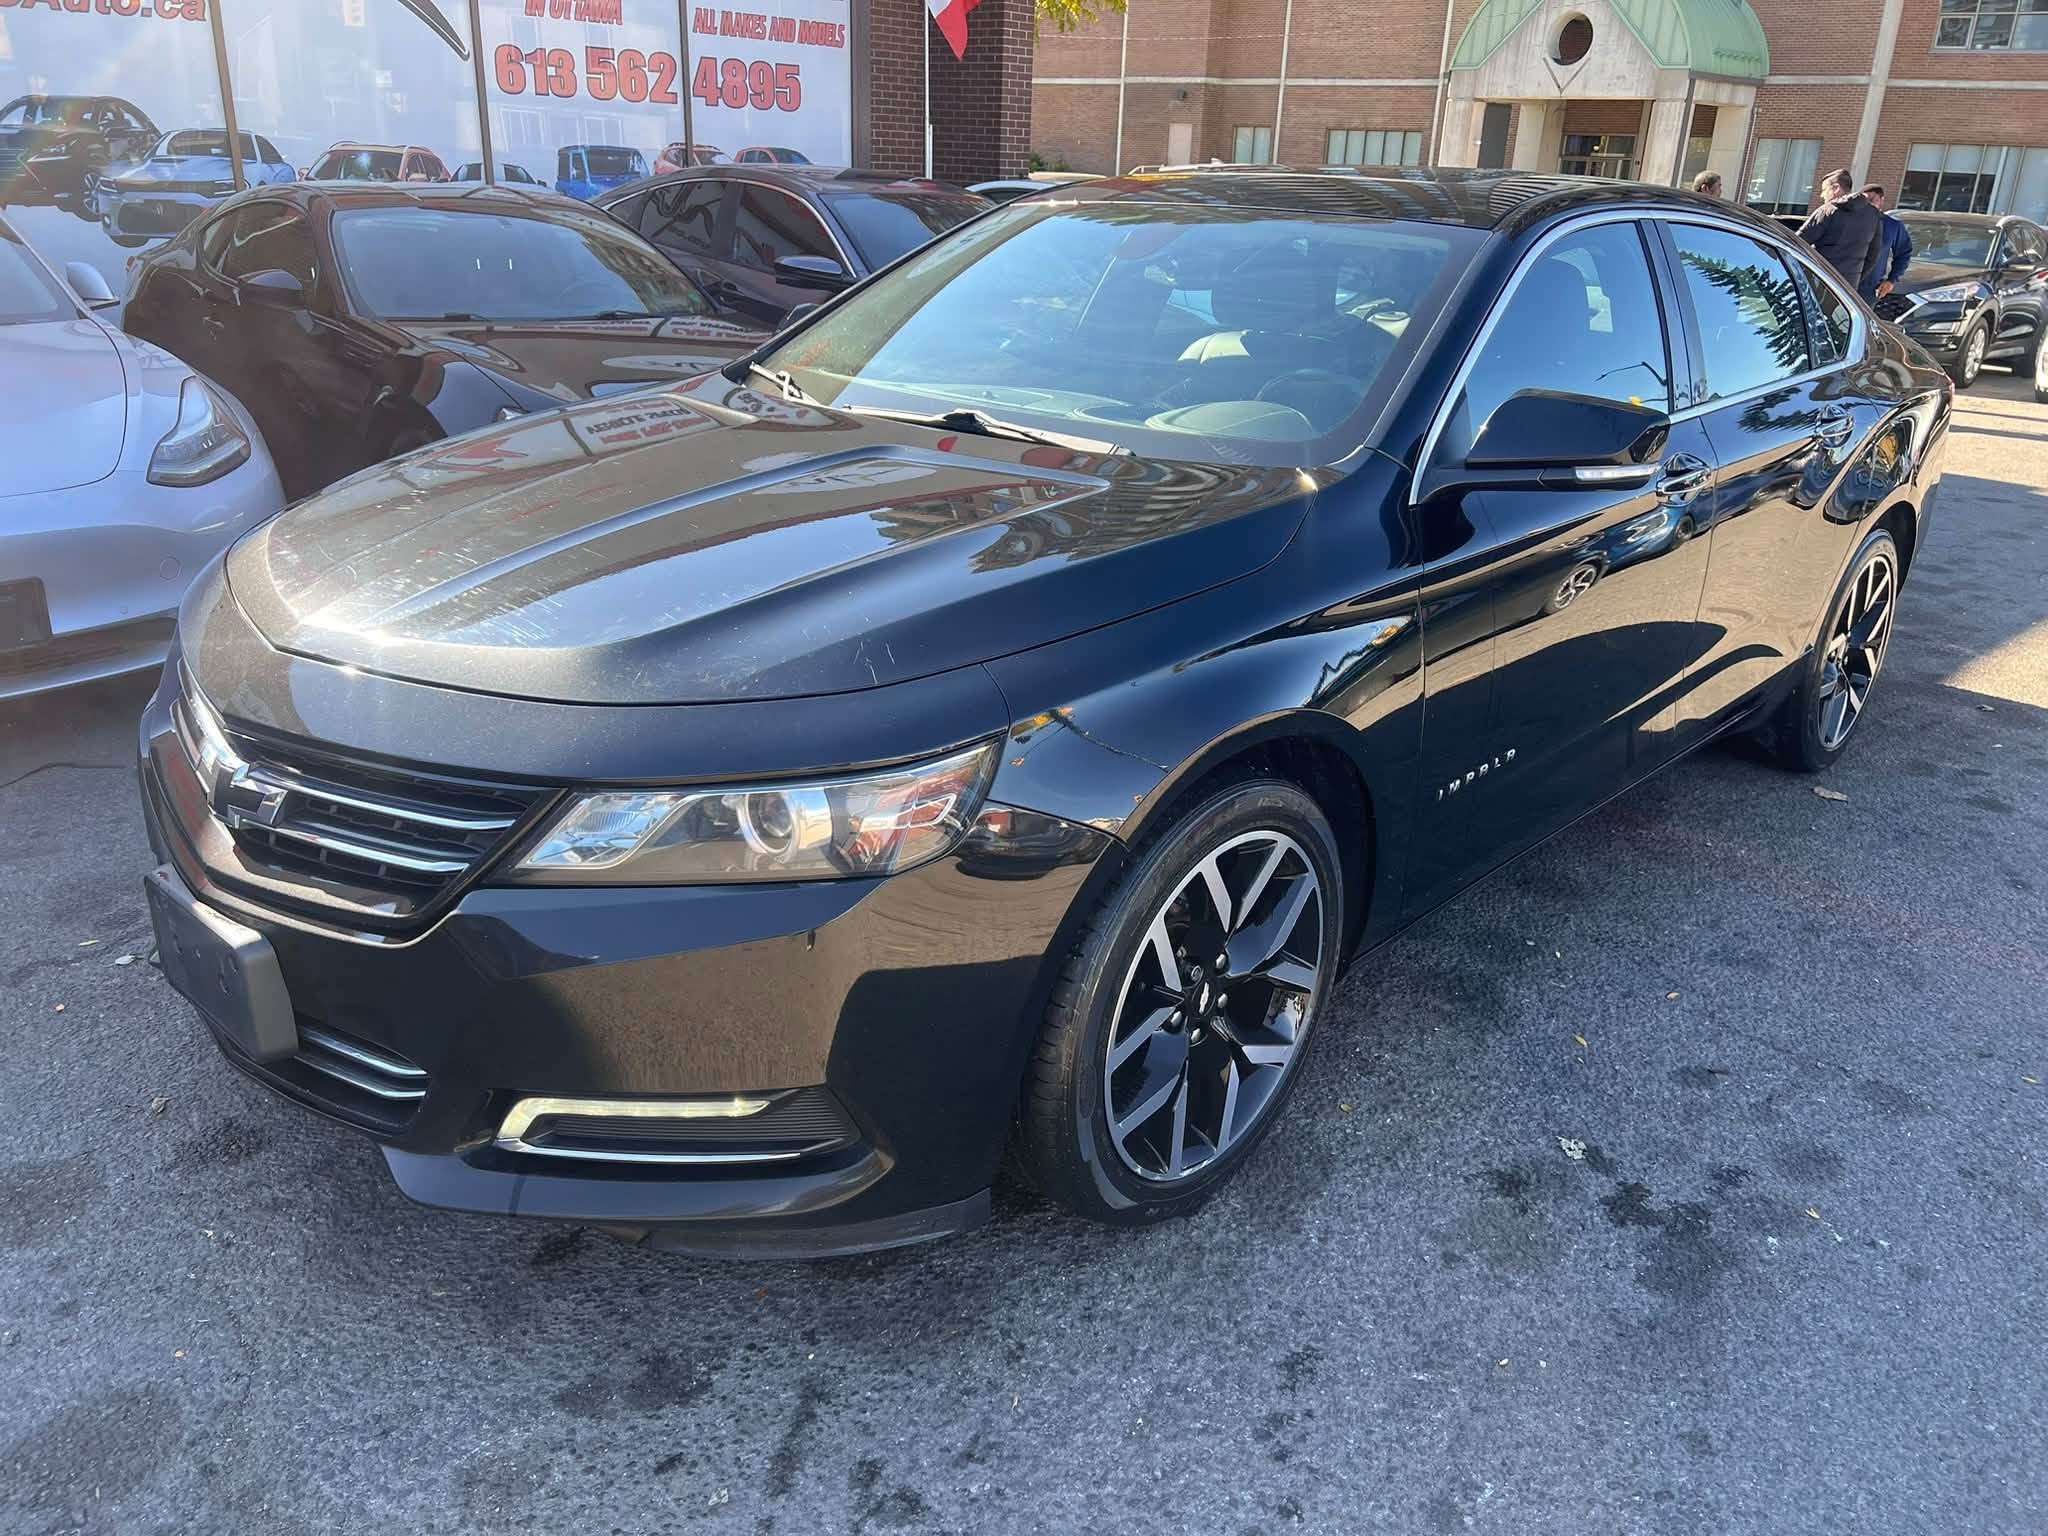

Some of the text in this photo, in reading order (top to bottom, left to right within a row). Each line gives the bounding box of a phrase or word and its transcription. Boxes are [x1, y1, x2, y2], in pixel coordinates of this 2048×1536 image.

[0, 0, 206, 21] uto.ca
[693, 8, 845, 48] ALL MAKES AND MODELS
[494, 44, 801, 112] 613 562 4895
[1439, 749, 1516, 800] IMPALA
